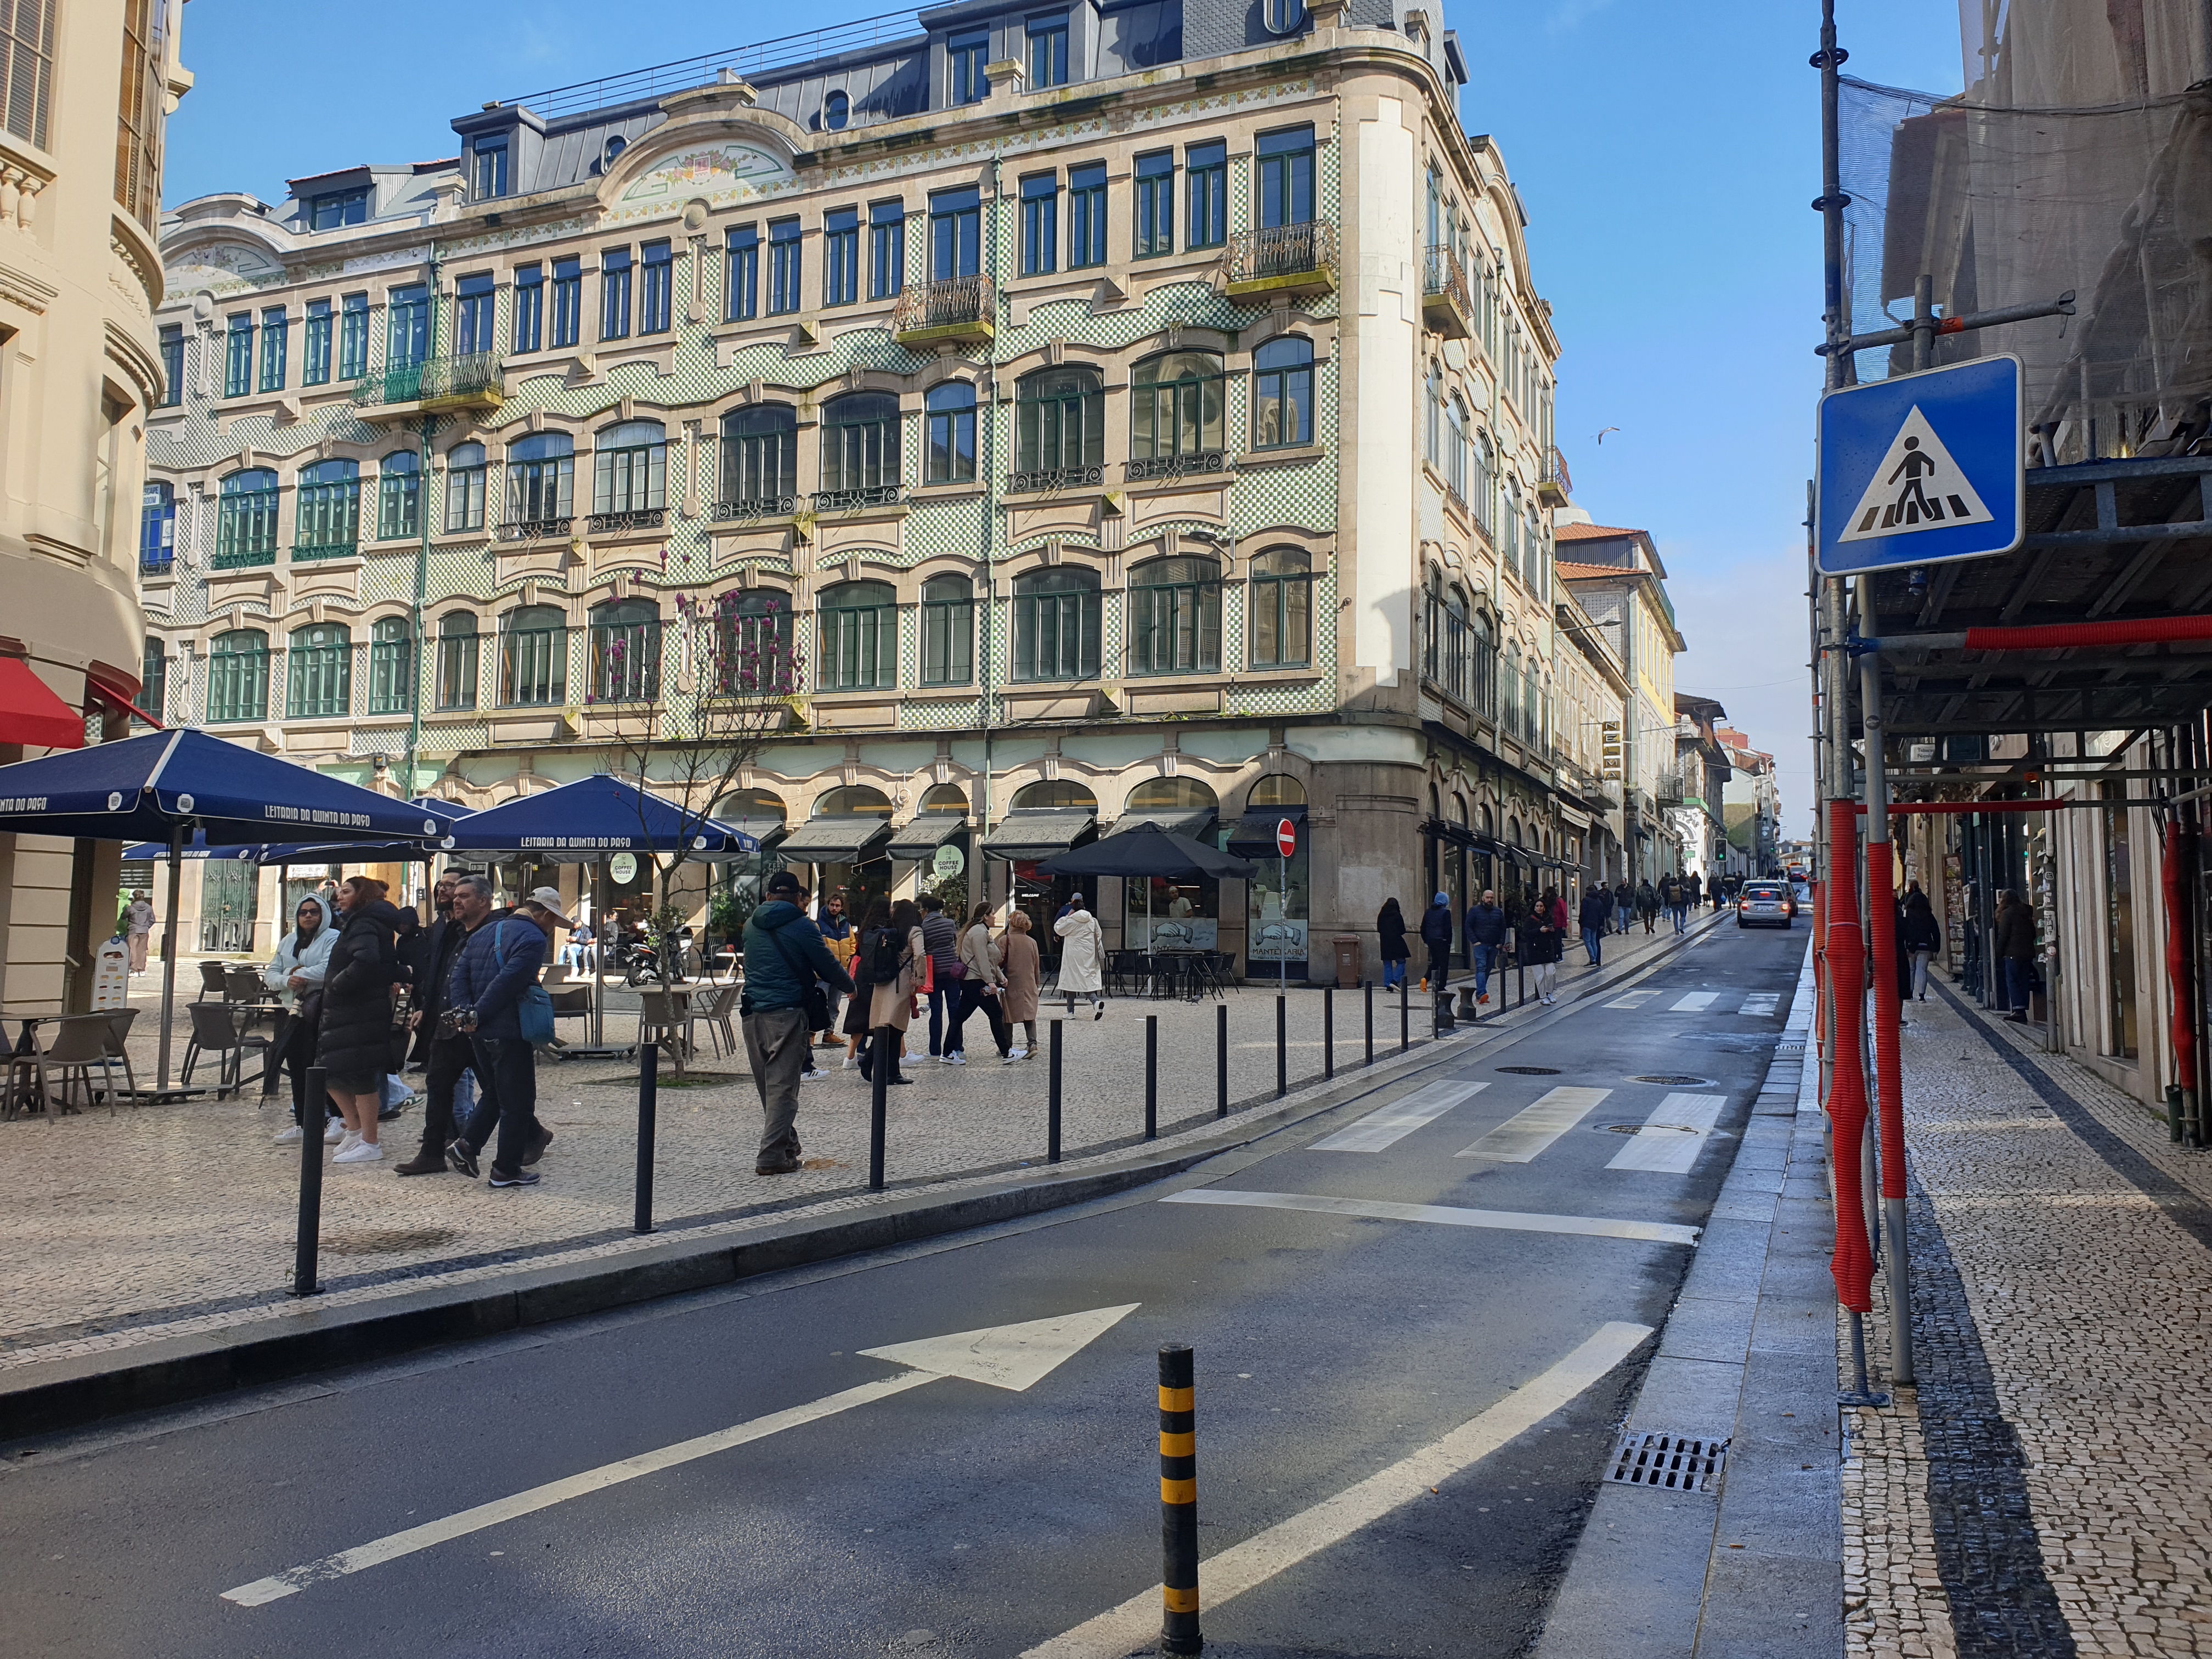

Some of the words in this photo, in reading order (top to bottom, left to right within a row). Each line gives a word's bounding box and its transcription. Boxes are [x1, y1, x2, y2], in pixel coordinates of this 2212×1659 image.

[1605, 721, 1619, 780] NELMA
[0, 798, 14, 812] NTA
[15, 798, 26, 811] DO
[27, 797, 47, 811] PAÇO
[265, 805, 298, 820] LEITARIA
[300, 808, 311, 821] DA
[312, 810, 338, 823] QUINTA
[340, 812, 349, 825] DO
[352, 814, 370, 827] PAÇO
[521, 837, 554, 847] LEITARIA
[556, 837, 566, 847] DA
[568, 837, 596, 847] QUINTA
[598, 837, 608, 848] DO
[611, 837, 631, 848] PAÇO
